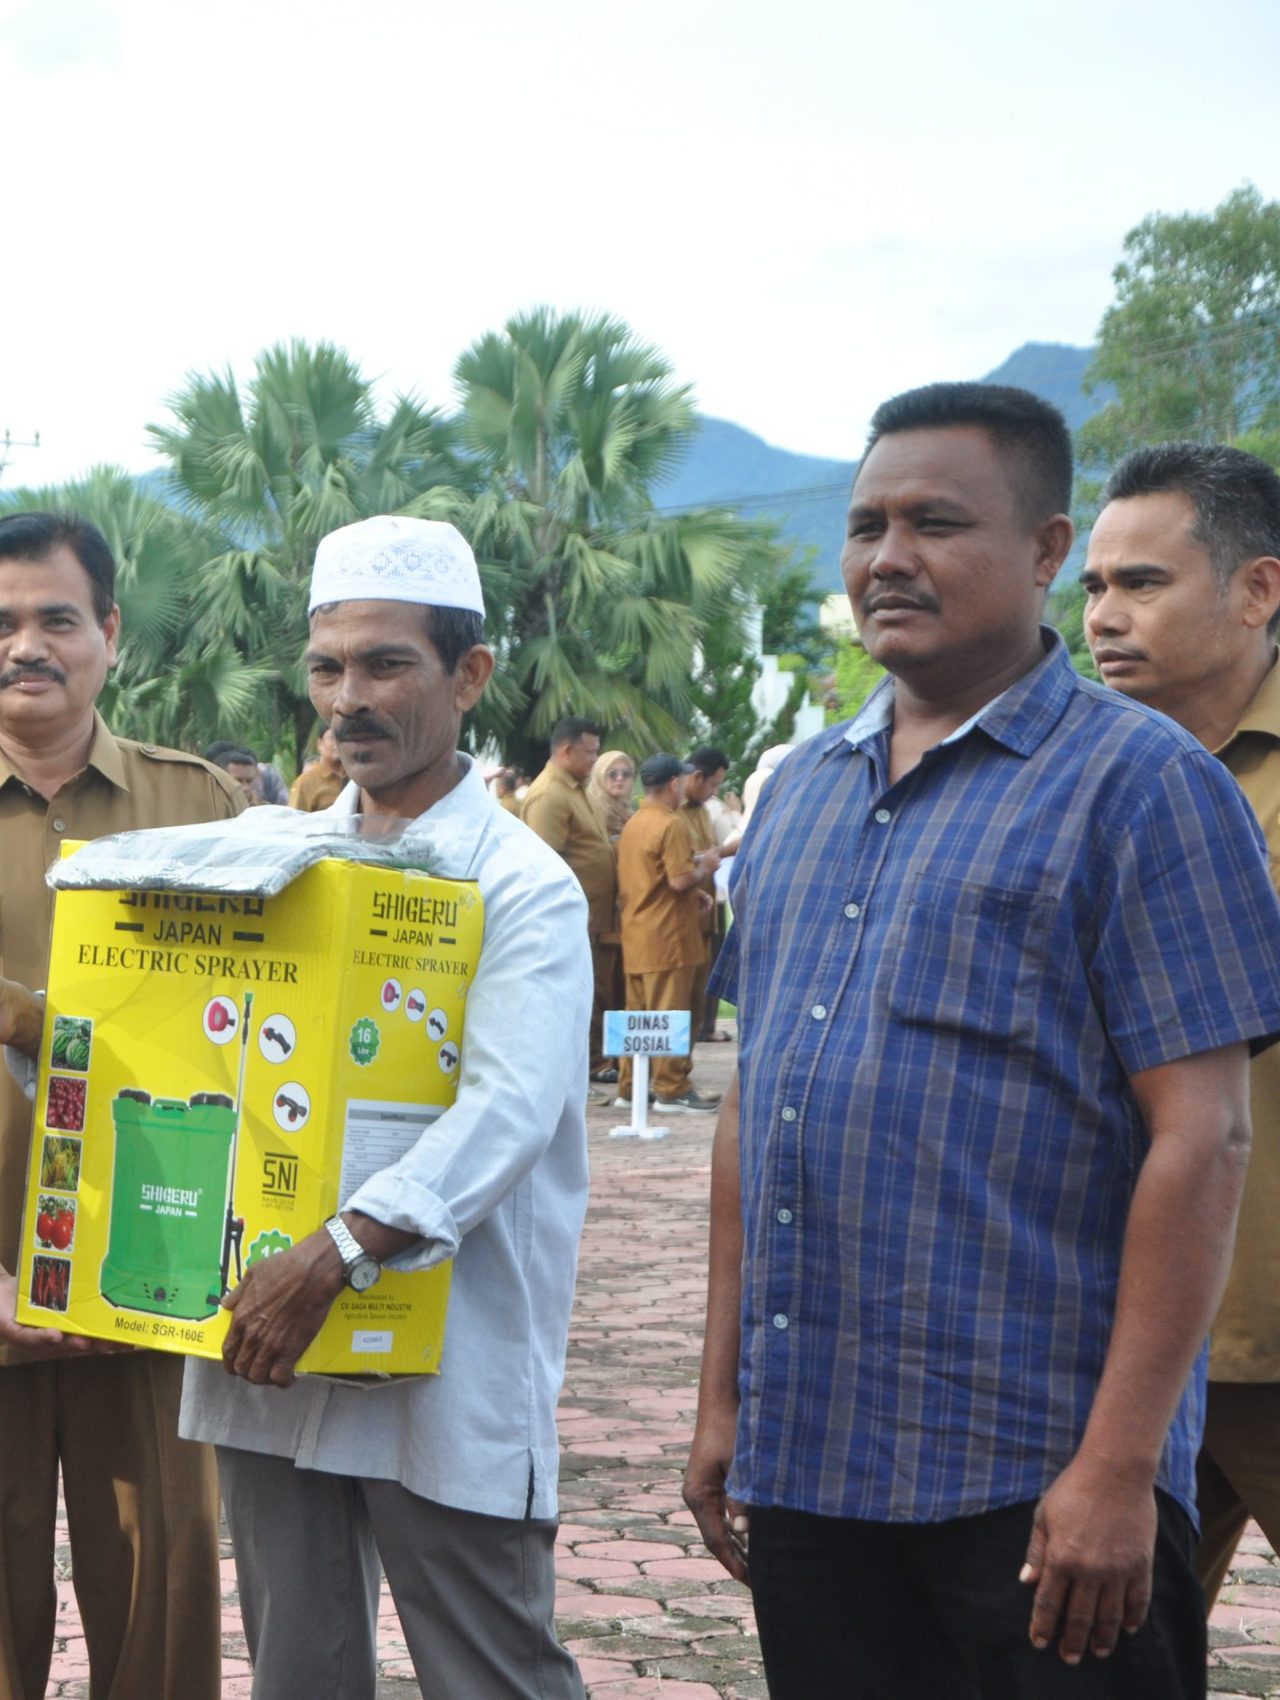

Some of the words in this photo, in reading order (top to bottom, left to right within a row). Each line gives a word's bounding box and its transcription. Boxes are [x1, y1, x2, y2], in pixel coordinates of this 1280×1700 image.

[372, 891, 458, 927] SHIGERU
[153, 919, 222, 945] JAPAN
[392, 928, 433, 946] JAPAN
[78, 943, 189, 974] ELECTRIC
[194, 953, 298, 984] SPRAYER
[353, 949, 414, 970] ELECTRIC
[415, 957, 469, 976] SPRAYER
[627, 1014, 670, 1031] DINAS
[357, 1027, 371, 1043] 16
[623, 1036, 672, 1052] SOSIAL
[262, 1159, 298, 1192] SNI
[141, 1184, 198, 1207] SHIGERU
[155, 1205, 183, 1216] JAPAN
[114, 1316, 150, 1334] Model:
[151, 1323, 205, 1343] SGR-160E
